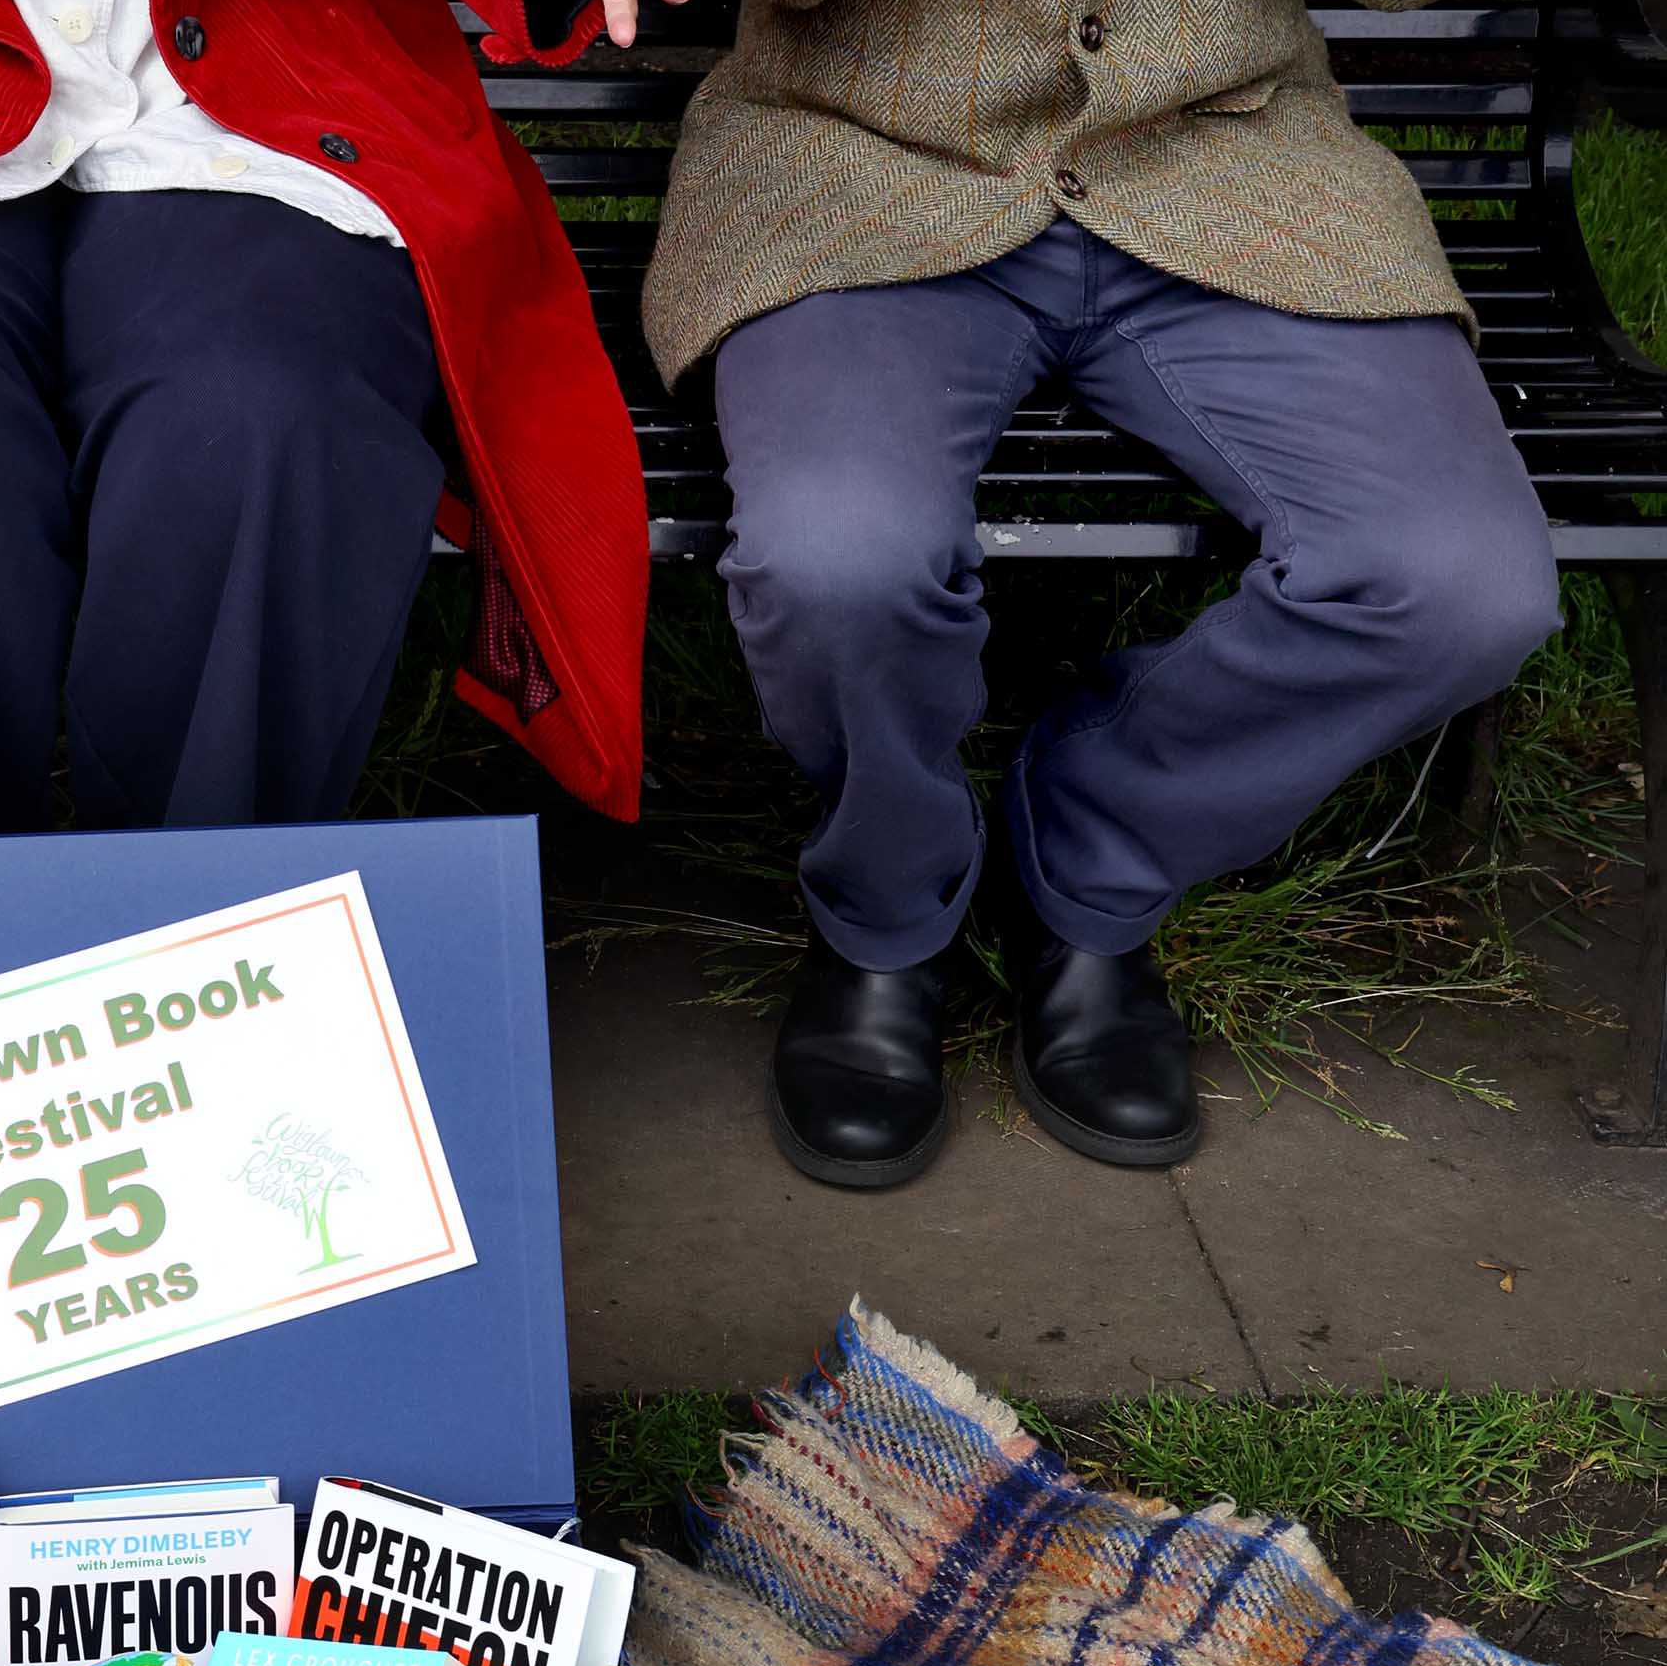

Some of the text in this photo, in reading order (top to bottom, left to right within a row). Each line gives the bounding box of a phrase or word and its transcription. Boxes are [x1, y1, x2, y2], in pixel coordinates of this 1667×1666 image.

[103, 956, 284, 1048] Book
[16, 1261, 200, 1344] YEARS
[30, 1529, 252, 1559] HENRY DIMBLEBY
[77, 1553, 206, 1571] with Jemima Lewis
[318, 1510, 563, 1645] OPERATION
[9, 1571, 277, 1664] RAVENOUS
